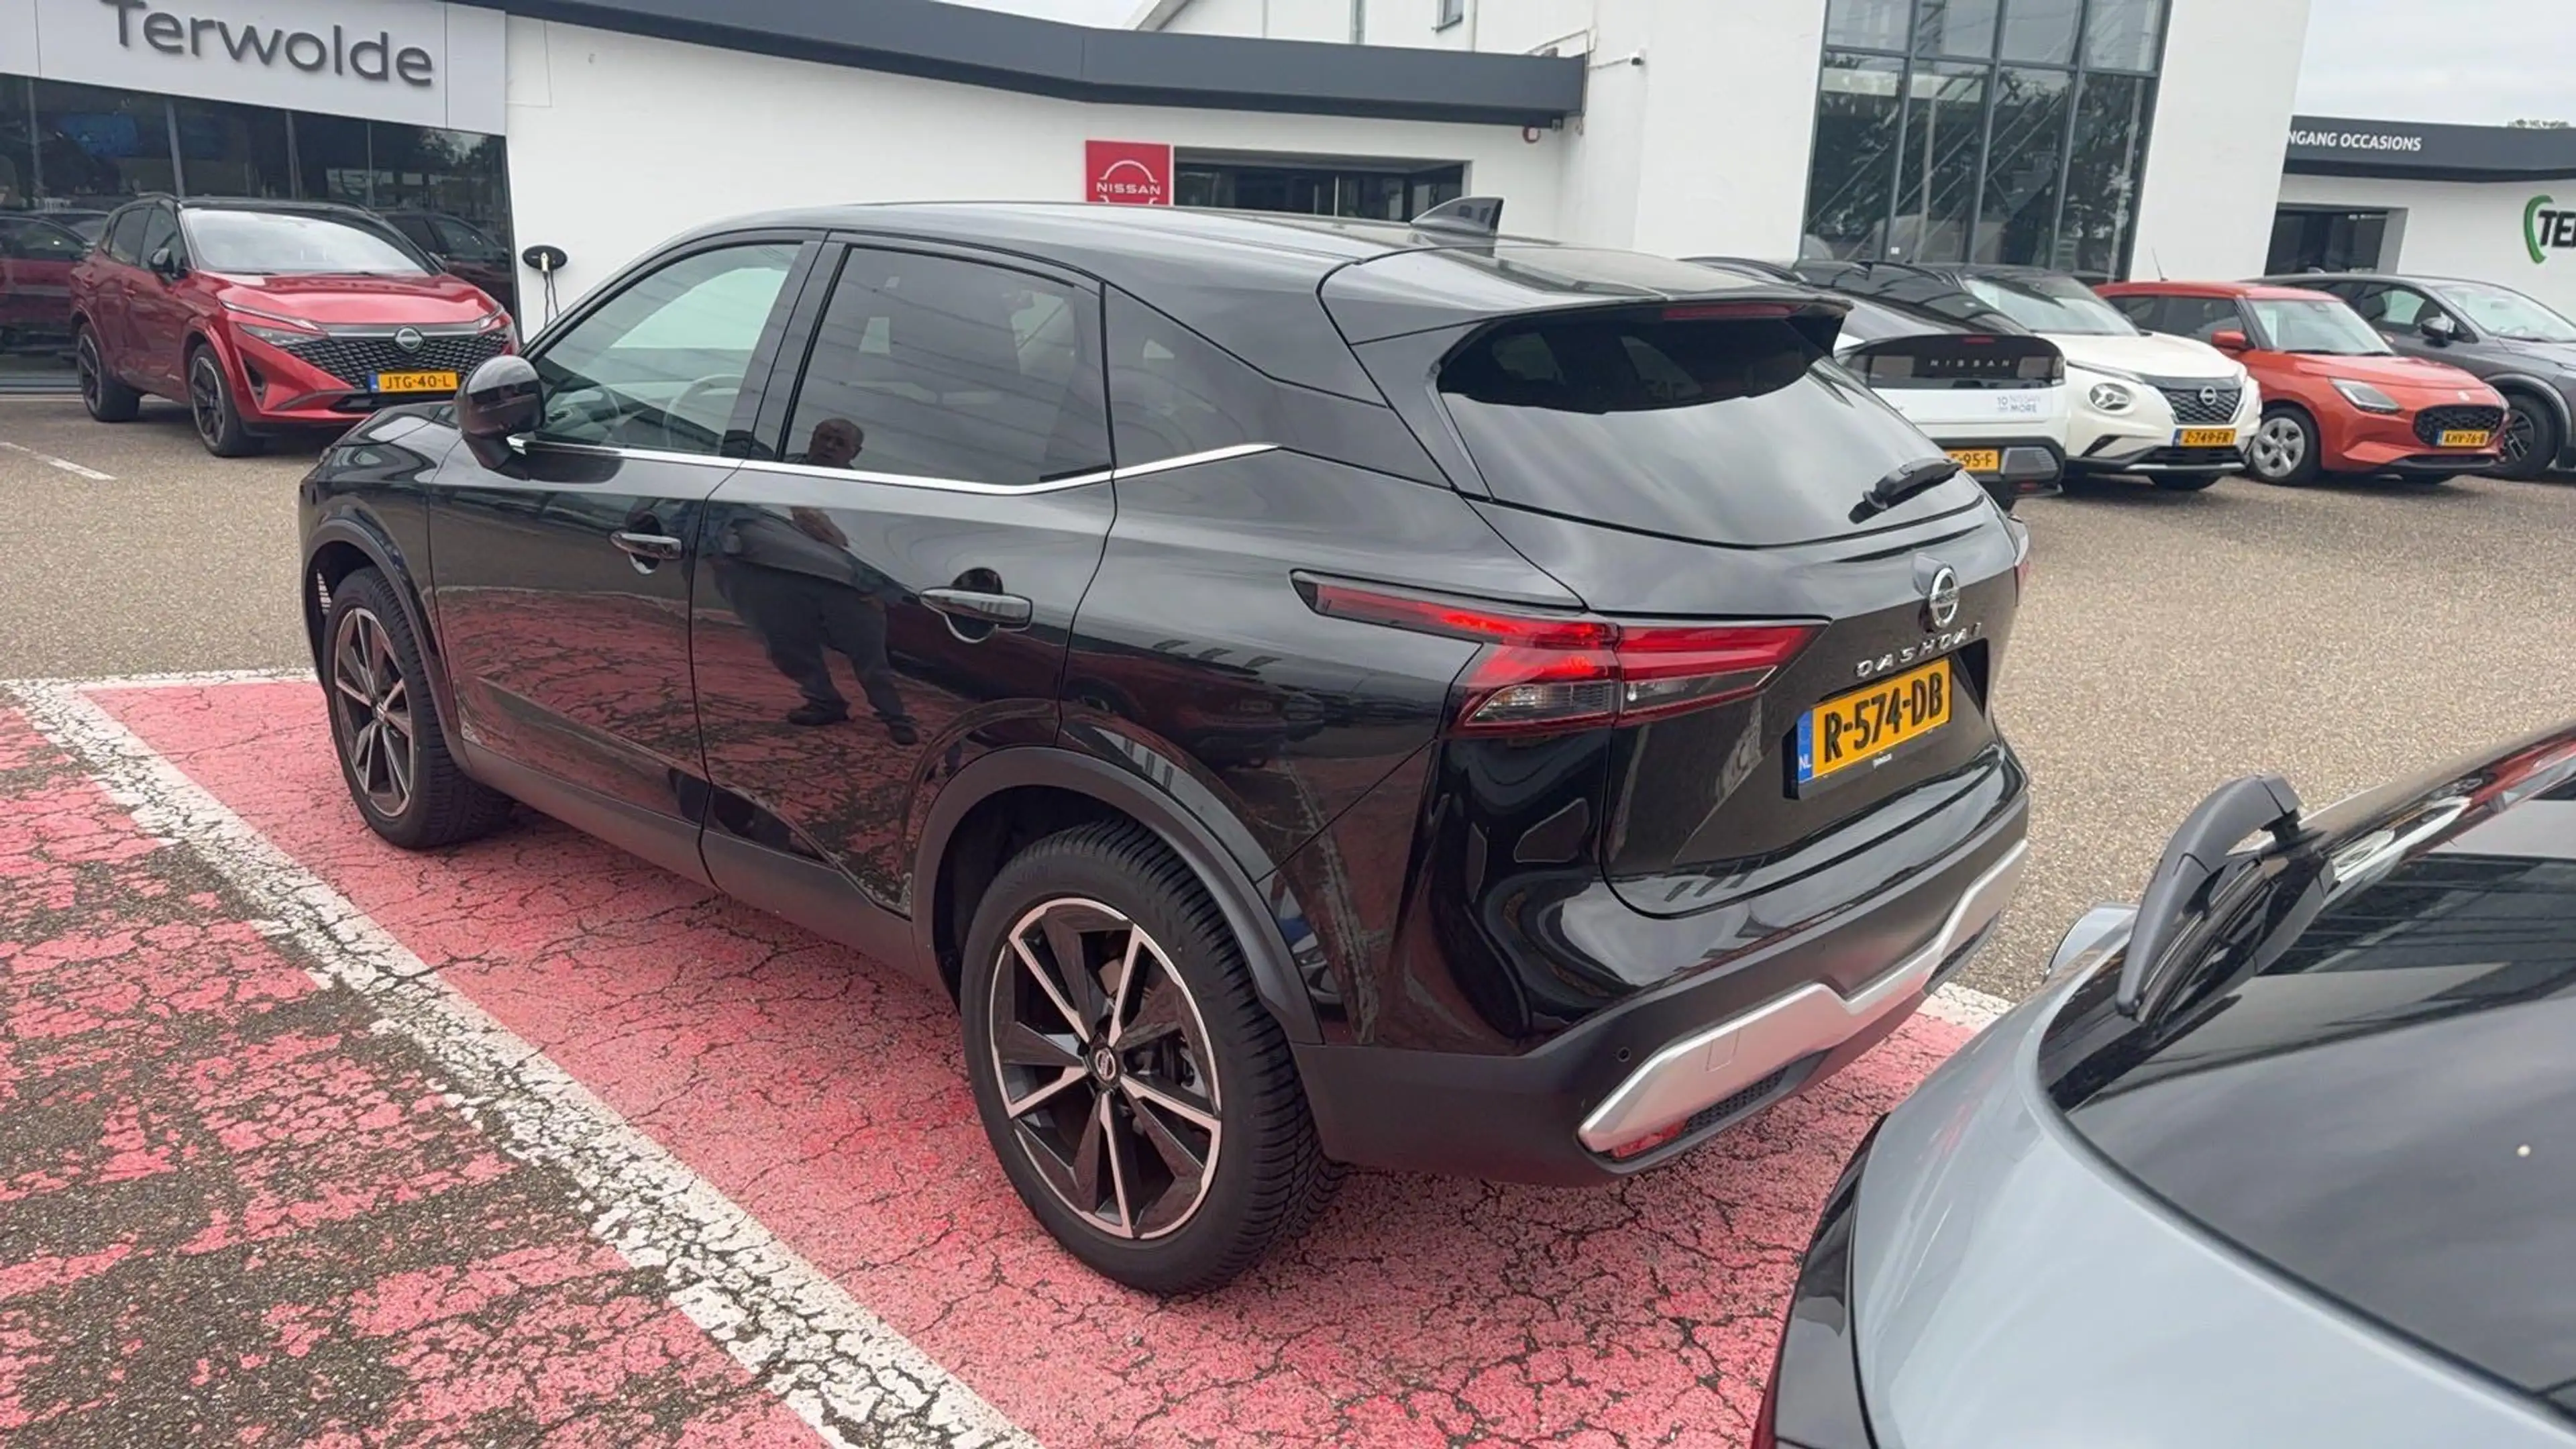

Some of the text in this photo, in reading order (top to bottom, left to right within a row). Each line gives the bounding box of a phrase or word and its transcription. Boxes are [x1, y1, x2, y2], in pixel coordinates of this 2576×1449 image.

[98, 0, 433, 87] Terwolde
[2340, 132, 2422, 152] OCCASIONS
[1095, 181, 1161, 195] NISSAN
[2538, 209, 2576, 248] TE
[1929, 358, 2010, 368] NISSAN
[386, 374, 451, 390] JTG-40-L
[1855, 622, 1982, 678] QASHQAI
[1799, 672, 1944, 772] NL R-574-DB
